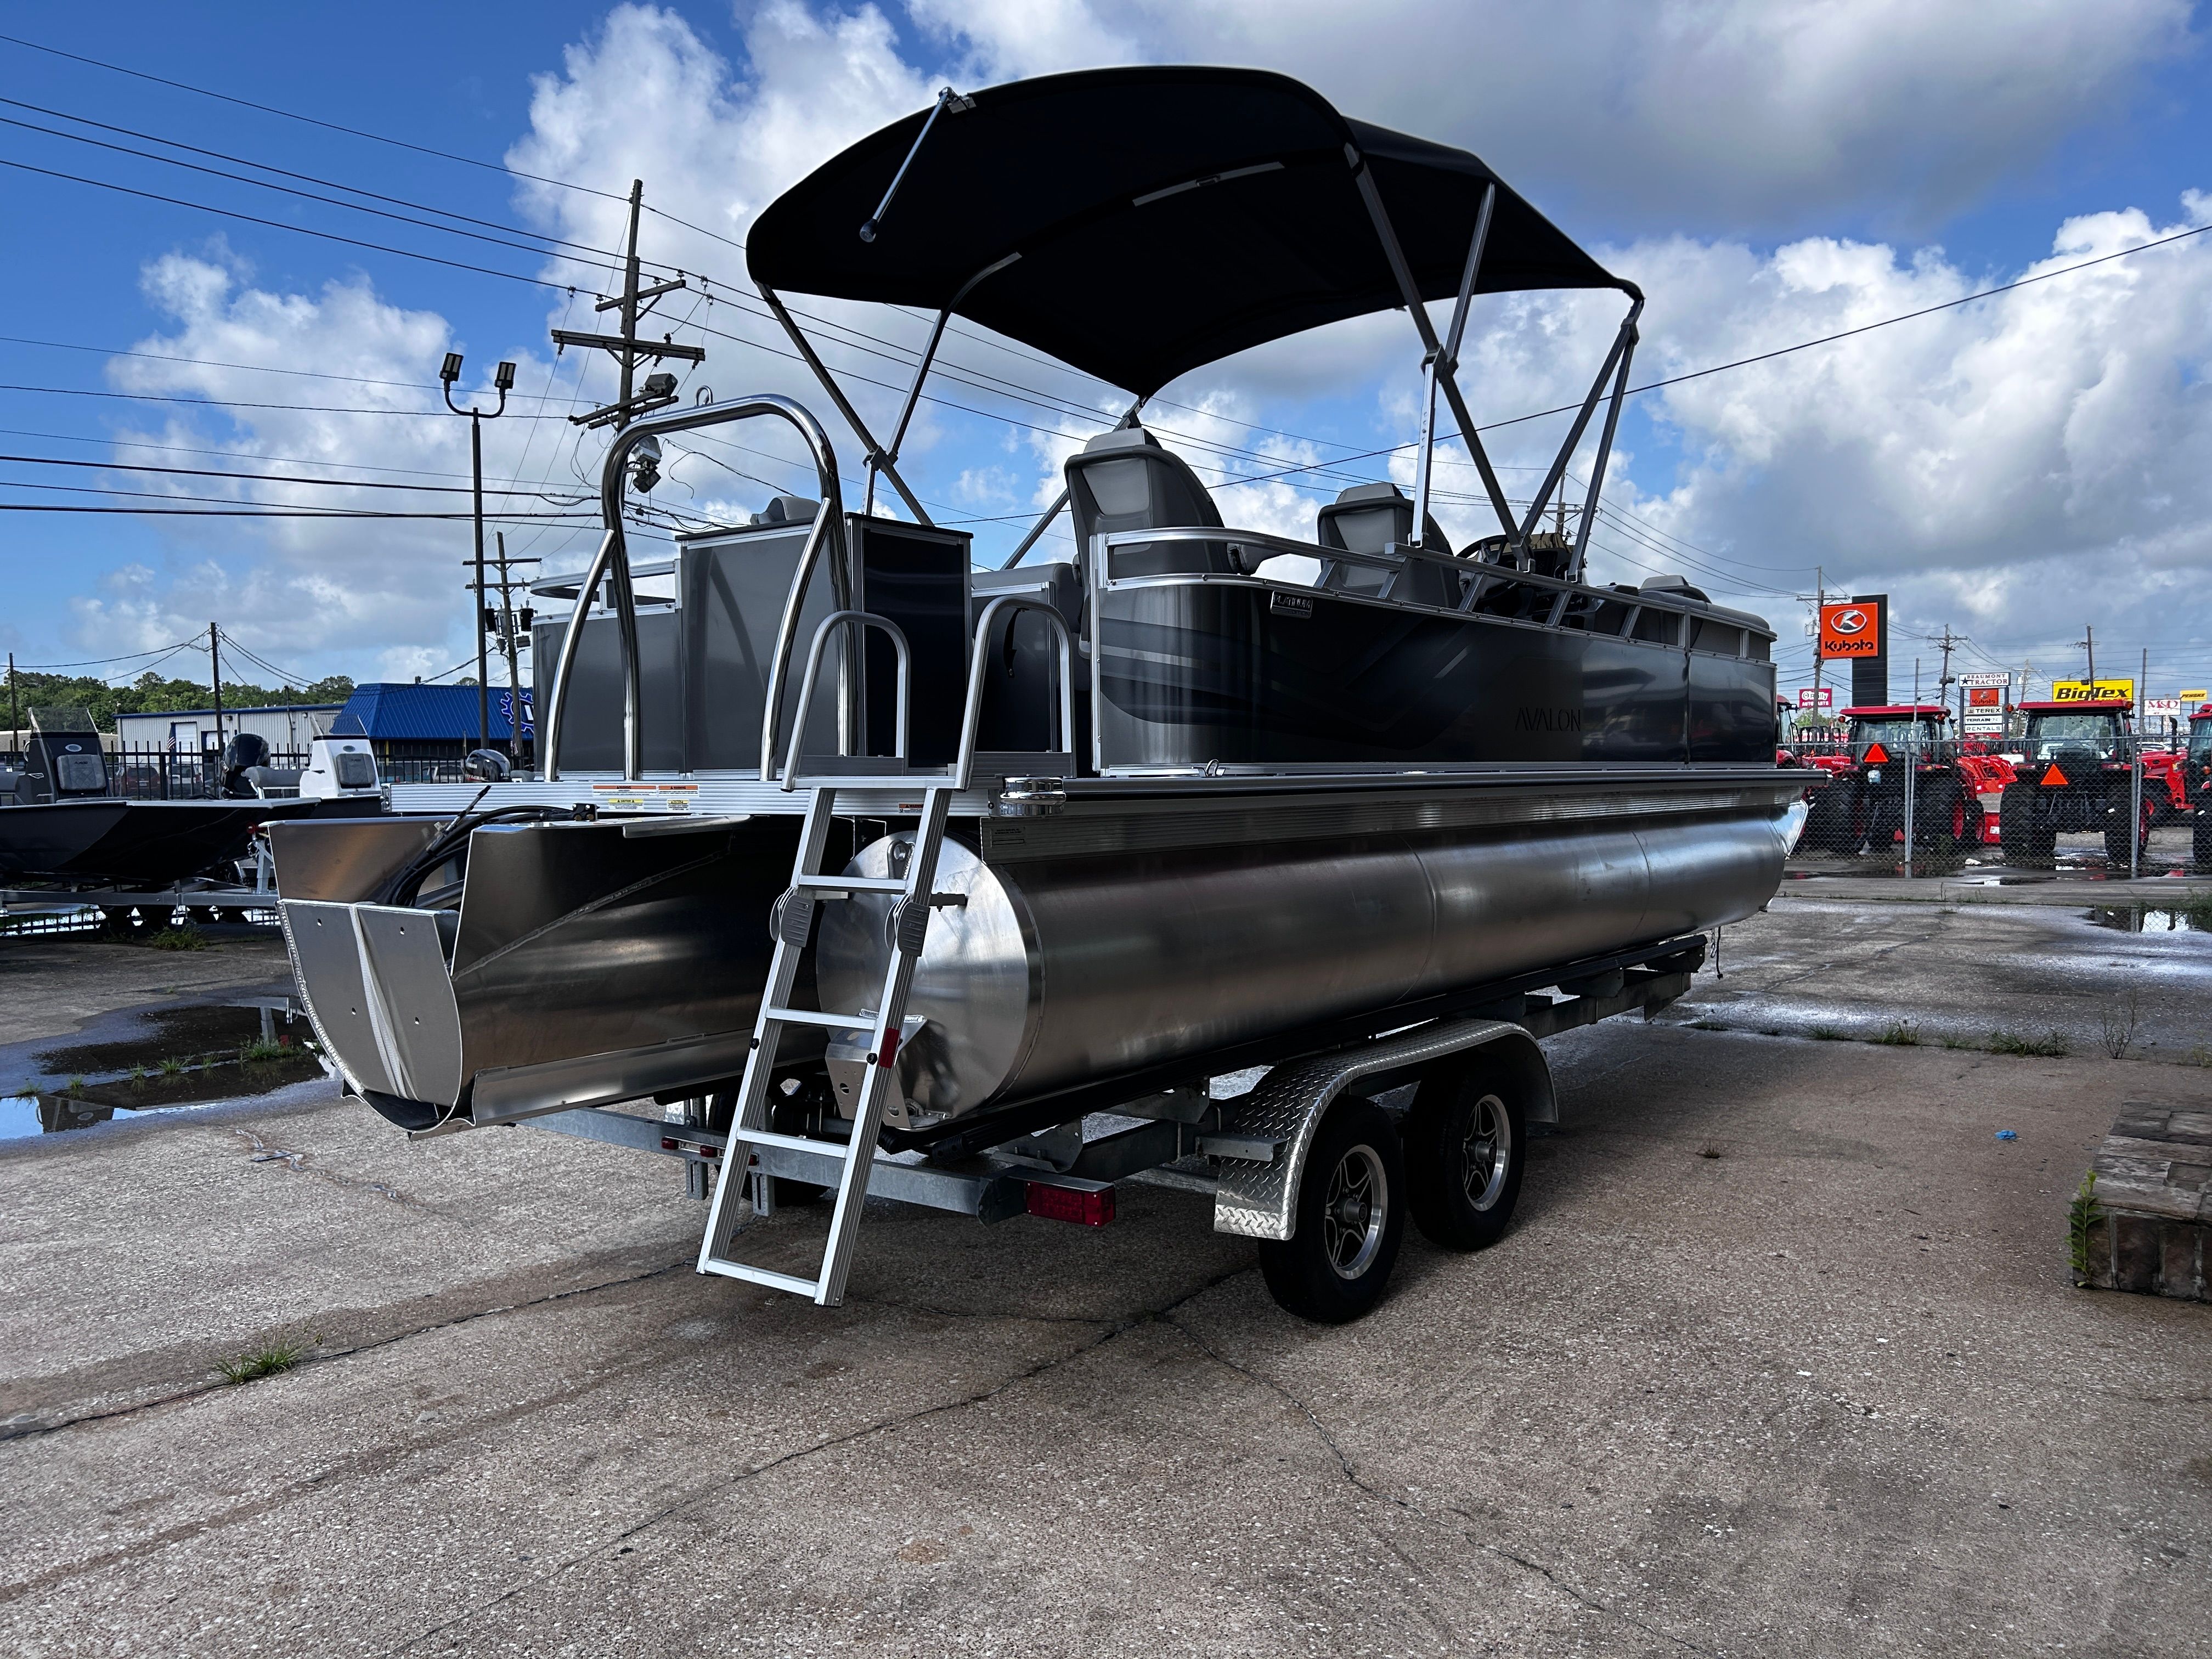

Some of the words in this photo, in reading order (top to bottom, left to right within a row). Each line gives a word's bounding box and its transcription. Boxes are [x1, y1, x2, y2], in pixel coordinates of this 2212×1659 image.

[1273, 595, 1312, 608] PLATINUM
[1825, 639, 1874, 652] Kubota
[1514, 707, 1581, 731] AVALON
